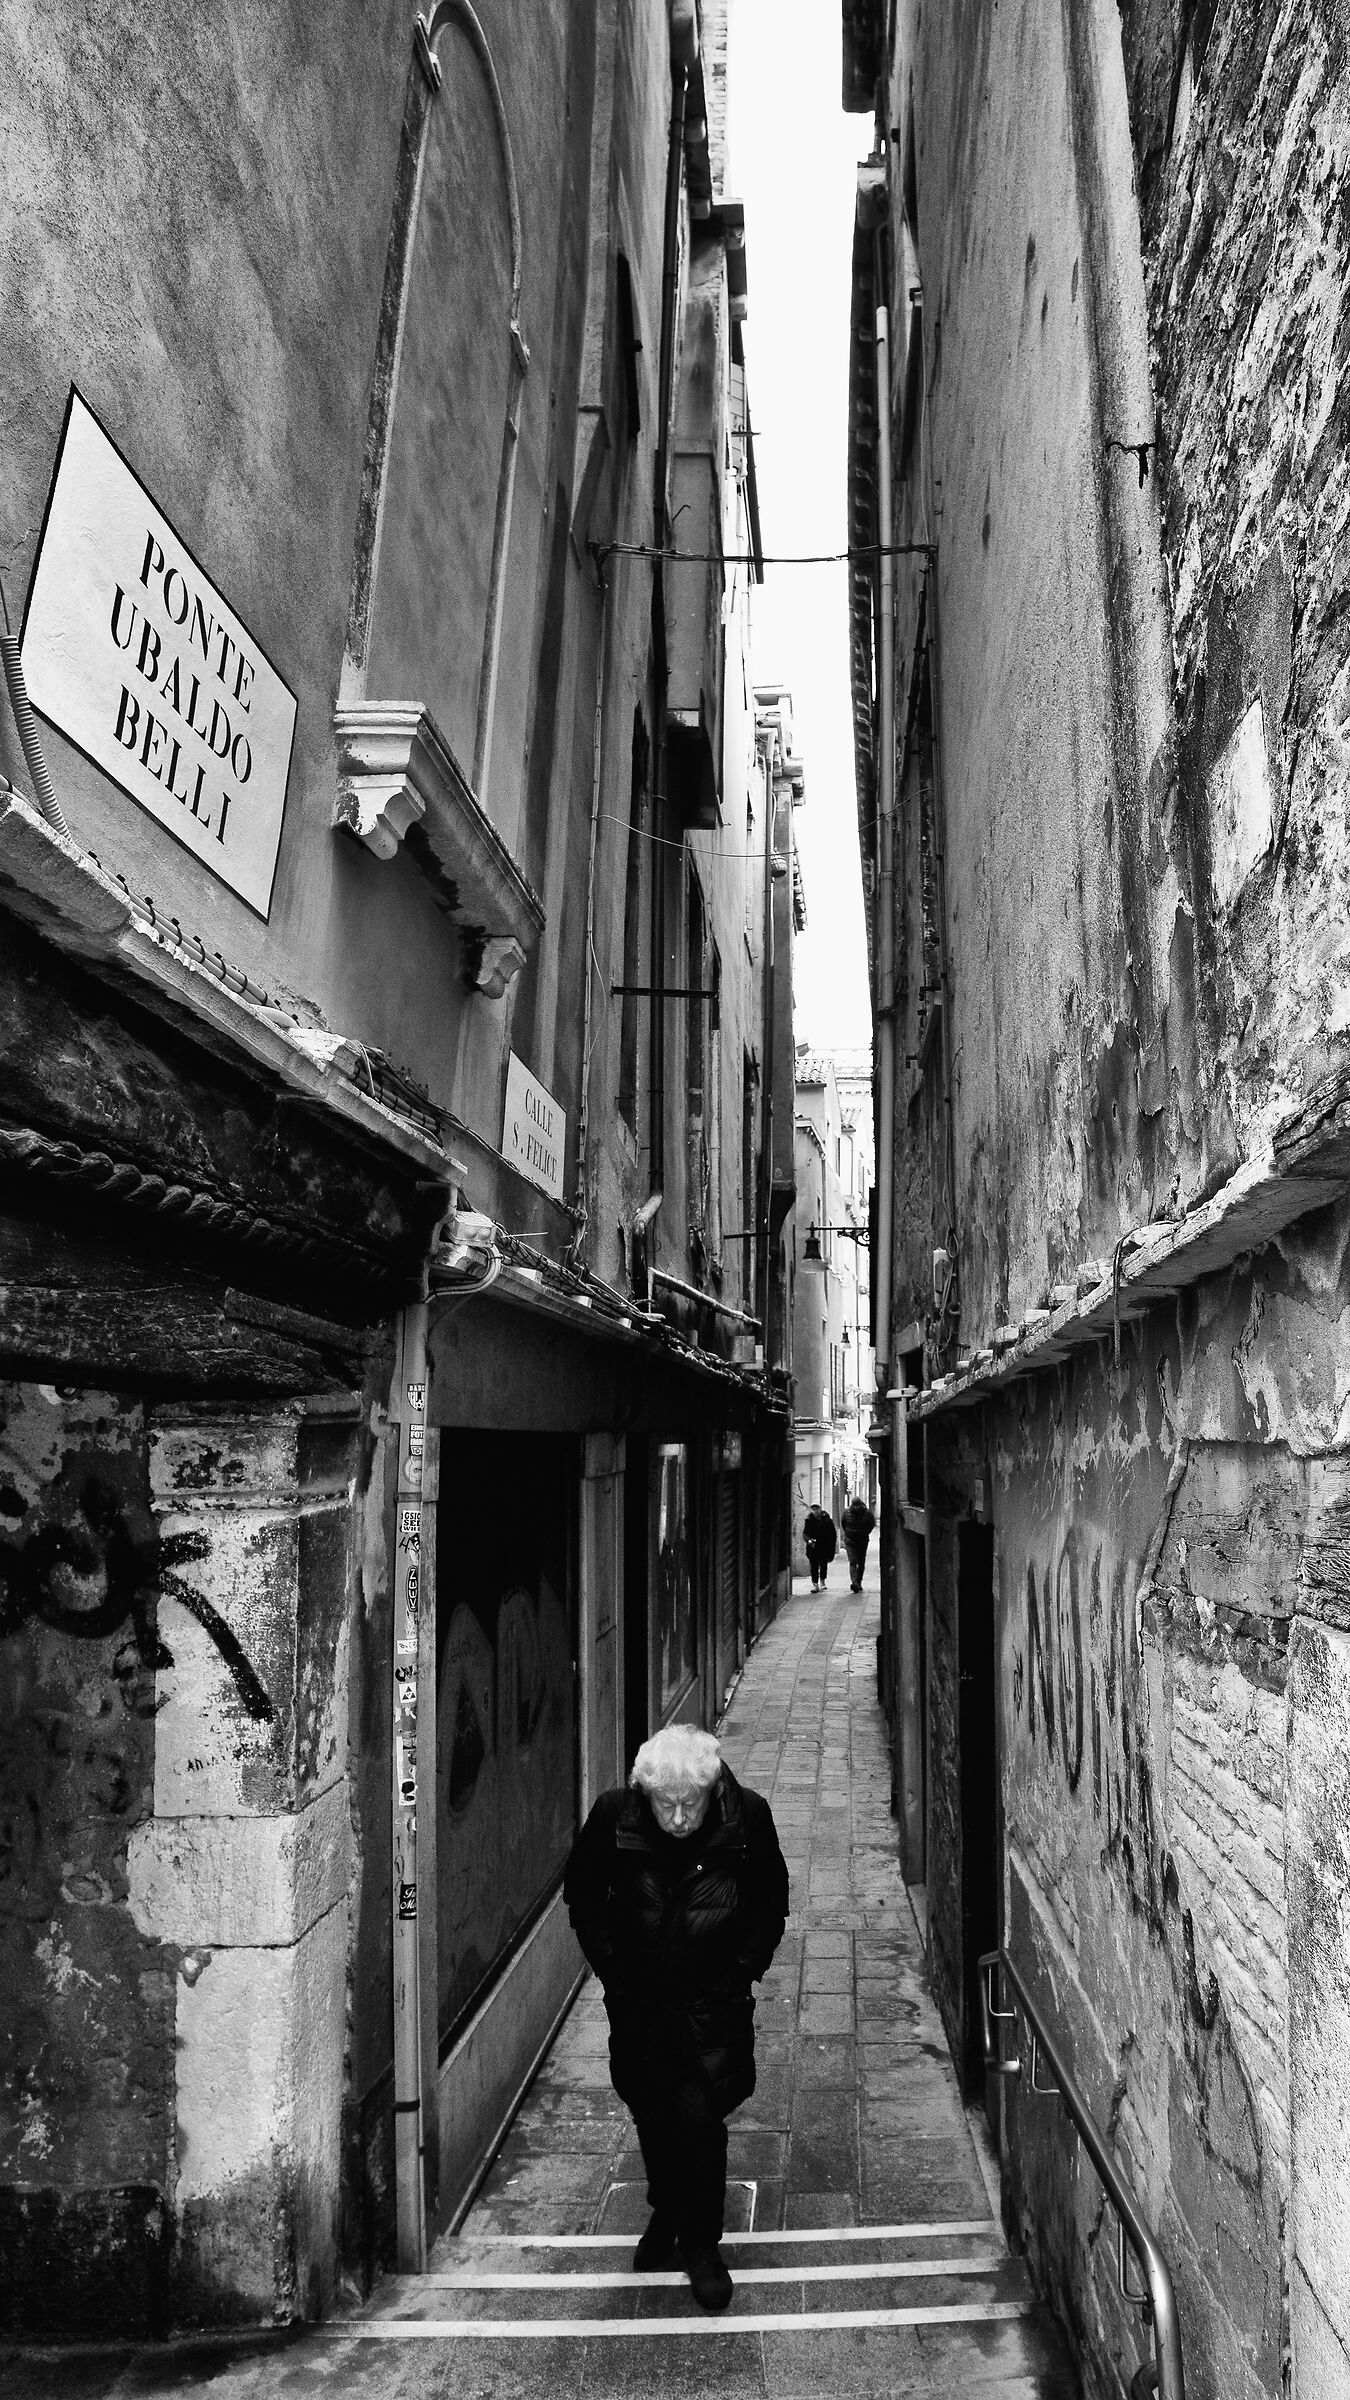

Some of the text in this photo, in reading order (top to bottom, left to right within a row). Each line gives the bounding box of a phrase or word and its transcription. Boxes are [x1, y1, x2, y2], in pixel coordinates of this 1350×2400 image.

[110, 583, 253, 785] UBALDO
[139, 530, 256, 715] PONTE
[113, 684, 231, 847] BELLI
[525, 1088, 553, 1138] CALLE
[527, 1134, 558, 1183] FELICE
